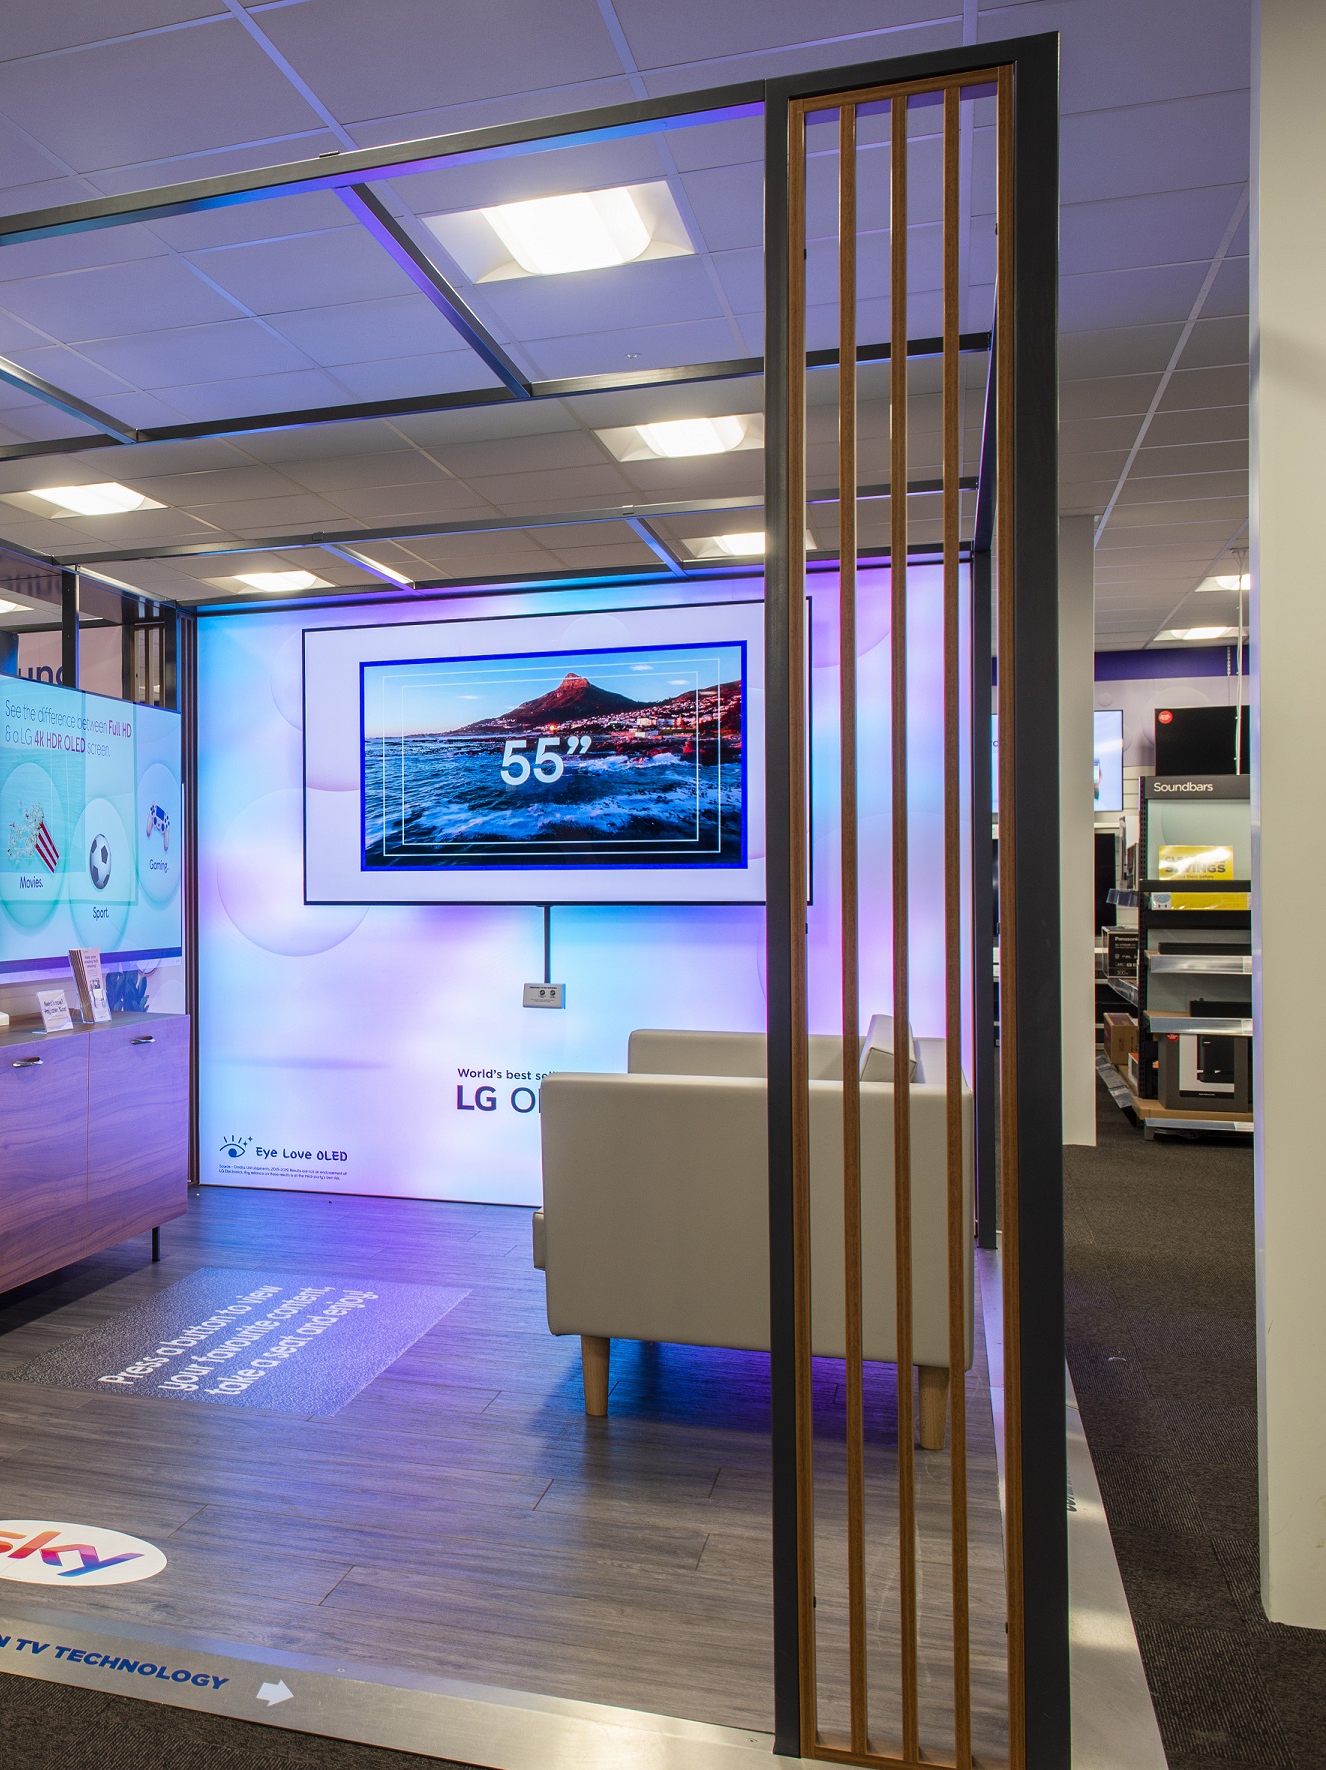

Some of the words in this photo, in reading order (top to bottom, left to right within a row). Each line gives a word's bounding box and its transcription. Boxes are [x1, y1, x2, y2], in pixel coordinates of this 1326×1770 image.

[5, 699, 22, 719] See
[23, 703, 36, 721] the
[38, 706, 76, 729] difference
[76, 716, 108, 735] between
[108, 719, 121, 737] Full
[122, 722, 132, 738] HD
[5, 725, 11, 743] &
[13, 730, 19, 743] a
[21, 727, 33, 746] LG
[34, 730, 45, 747] 4K
[46, 732, 62, 750] HDR
[64, 735, 86, 753] OLED
[87, 740, 111, 758] screen.
[1153, 781, 1214, 793] Soundbars
[149, 859, 169, 873] Gaming.
[1165, 864, 1226, 873] SVINGS
[19, 875, 44, 889] Movies.
[92, 906, 110, 921] Sport.
[457, 1068, 502, 1080] World's
[506, 1069, 532, 1081] best
[457, 1085, 497, 1112] LG
[255, 1147, 278, 1160] Eye
[282, 1148, 312, 1160] Love
[316, 1150, 348, 1162] OLED
[236, 1285, 283, 1306] view
[219, 1304, 252, 1319] to
[158, 1363, 215, 1392] your
[191, 1319, 280, 1363] favourite
[266, 1286, 336, 1320] content,
[160, 1315, 236, 1347] button
[156, 1346, 185, 1357] a
[204, 1367, 266, 1395] take
[250, 1358, 282, 1369] a
[270, 1335, 312, 1359] seat
[296, 1314, 340, 1336] and
[98, 1355, 170, 1386] Press
[14, 1638, 50, 1655] TV
[53, 1645, 231, 1690] TECHNOLOGY
